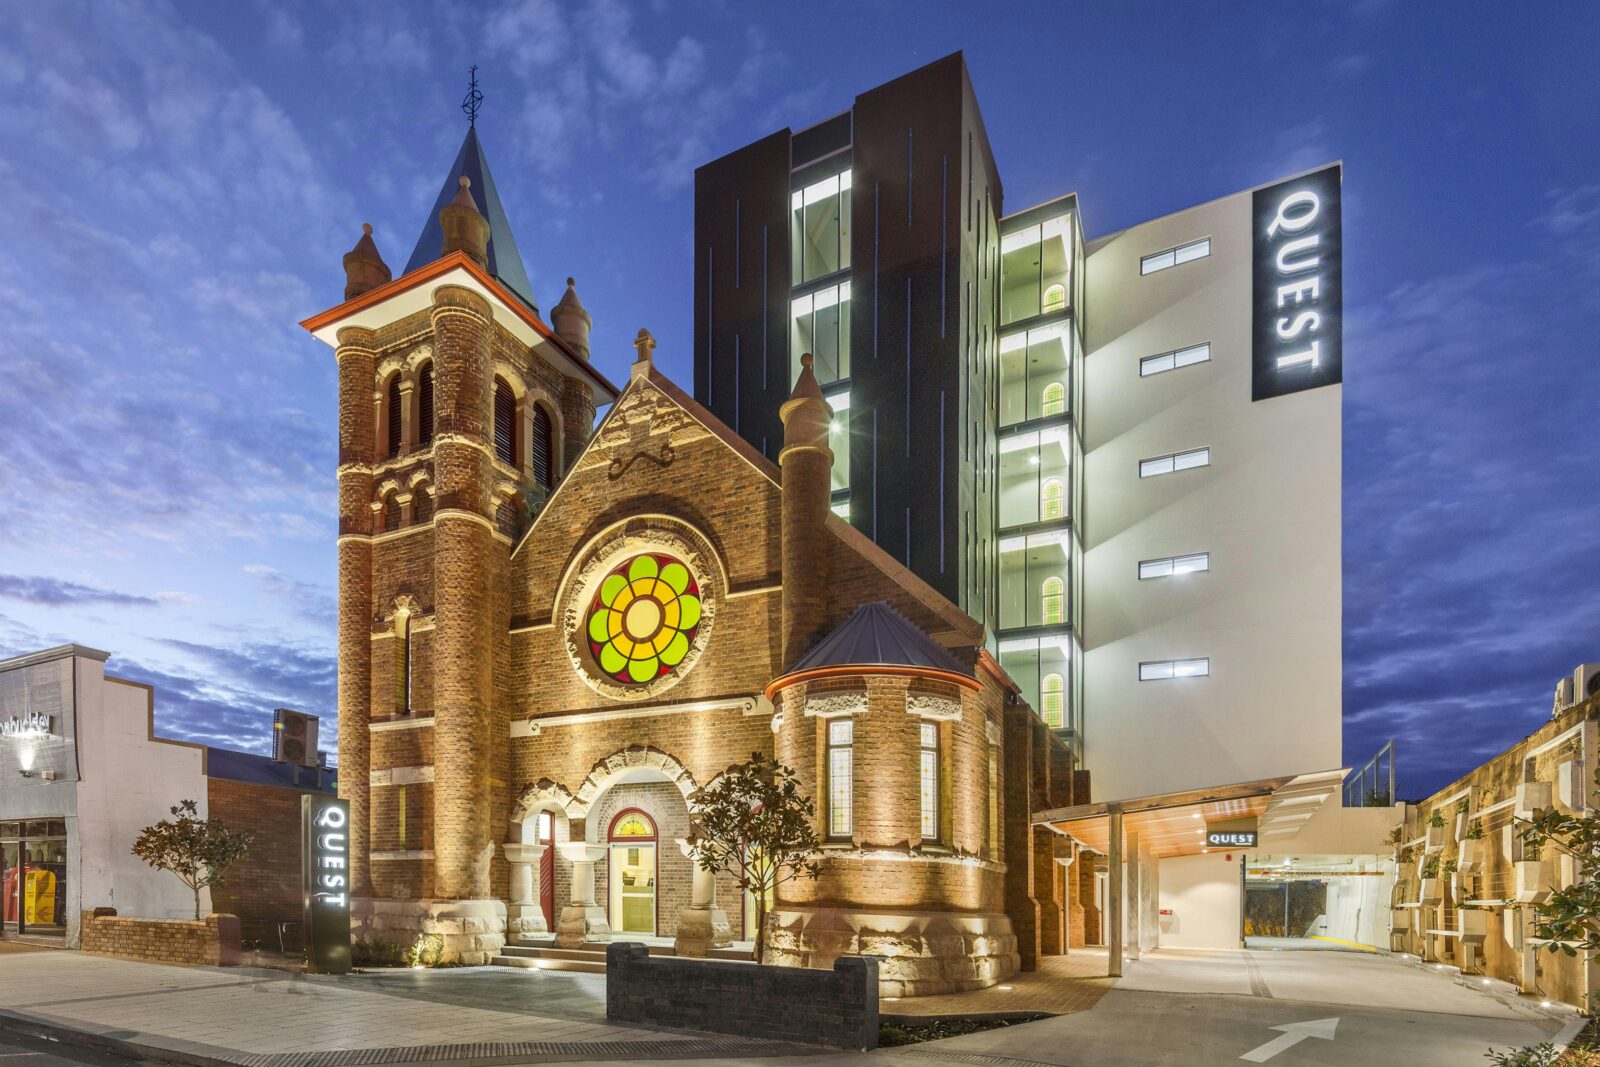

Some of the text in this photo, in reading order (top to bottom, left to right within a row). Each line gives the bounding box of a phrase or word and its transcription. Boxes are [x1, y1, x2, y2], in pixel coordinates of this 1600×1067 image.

[1267, 191, 1320, 370] QUEST
[320, 806, 345, 907] QUEST
[1210, 834, 1254, 844] QUEST
